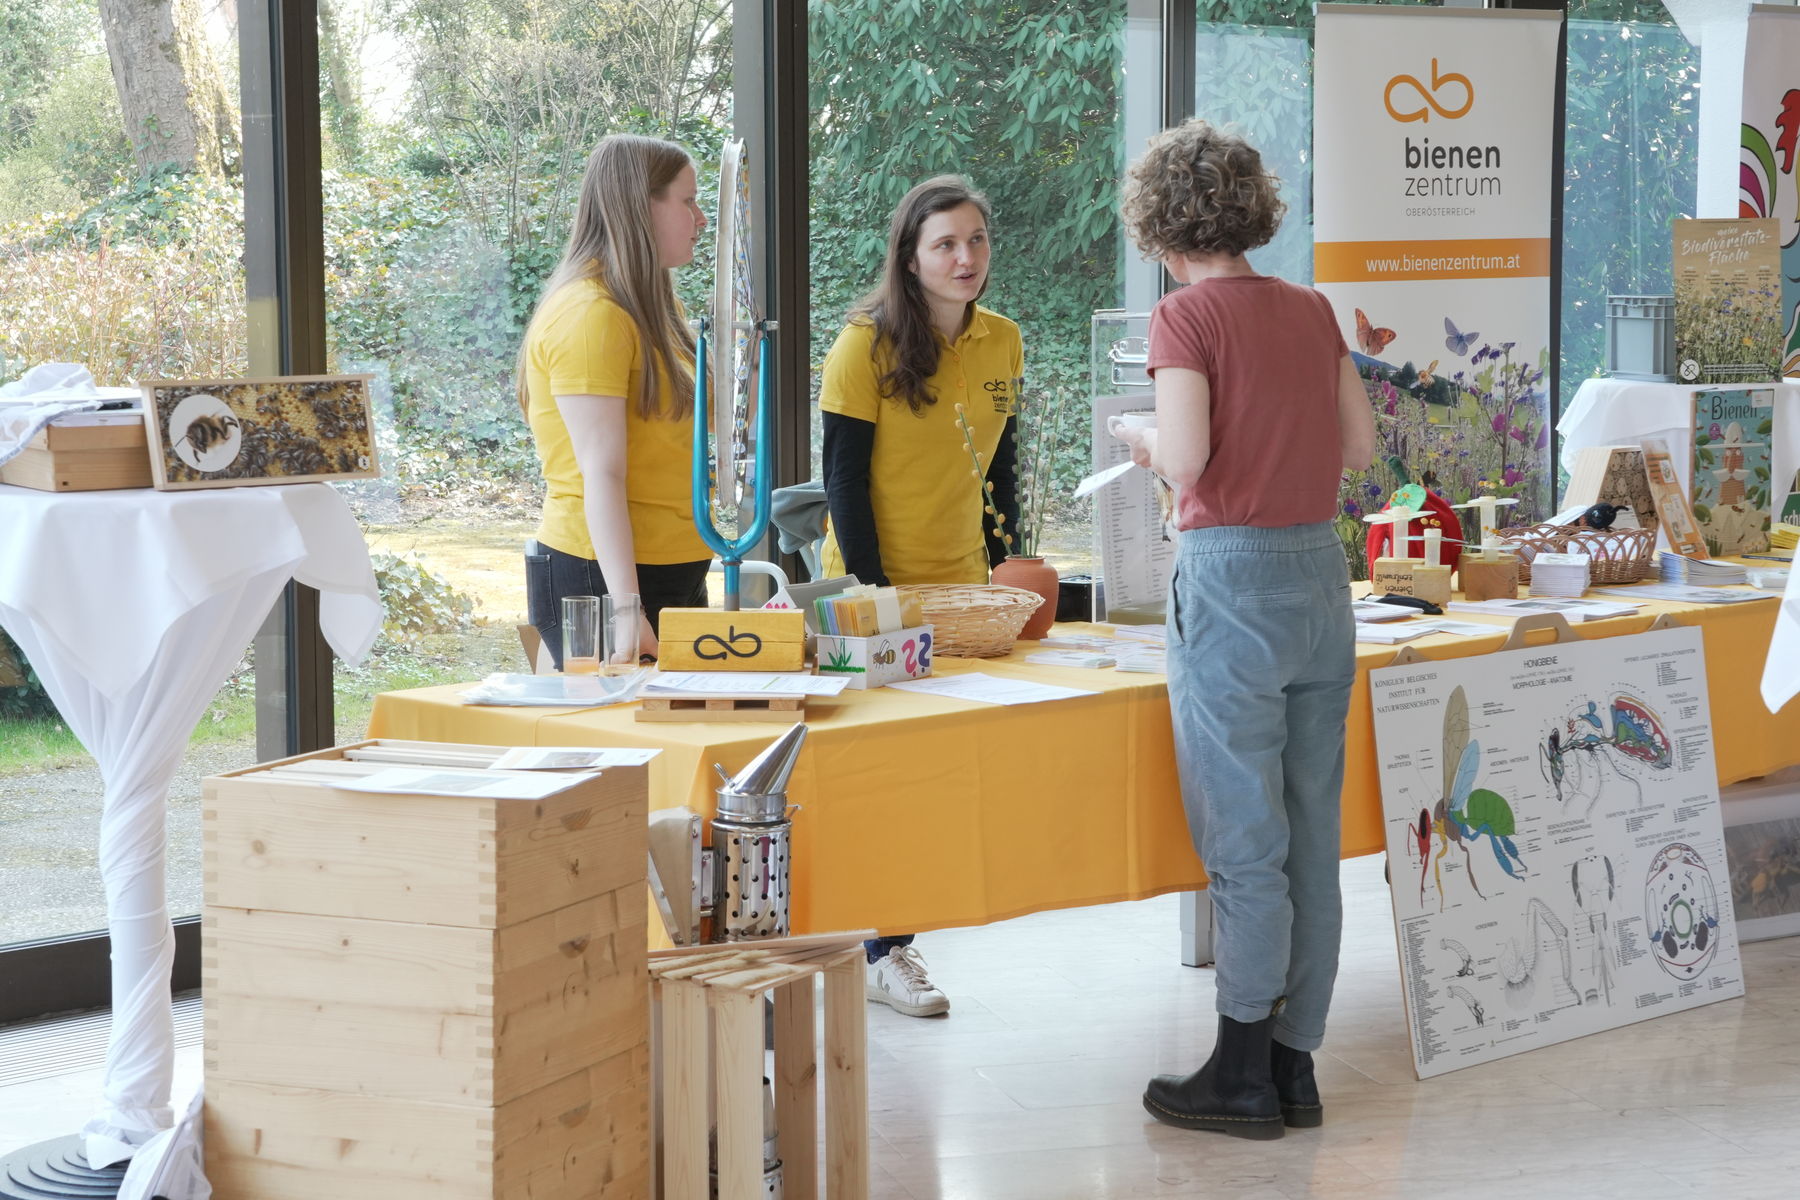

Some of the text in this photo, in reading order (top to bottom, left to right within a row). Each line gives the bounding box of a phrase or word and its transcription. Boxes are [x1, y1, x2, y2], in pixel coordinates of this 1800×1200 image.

[1405, 136, 1501, 169] bienen
[1405, 173, 1501, 197] zentrum
[1405, 206, 1476, 217] OBERÖSTERREICH
[1366, 253, 1520, 272] www.bienenzentrum.at
[1711, 395, 1758, 420] Bienen
